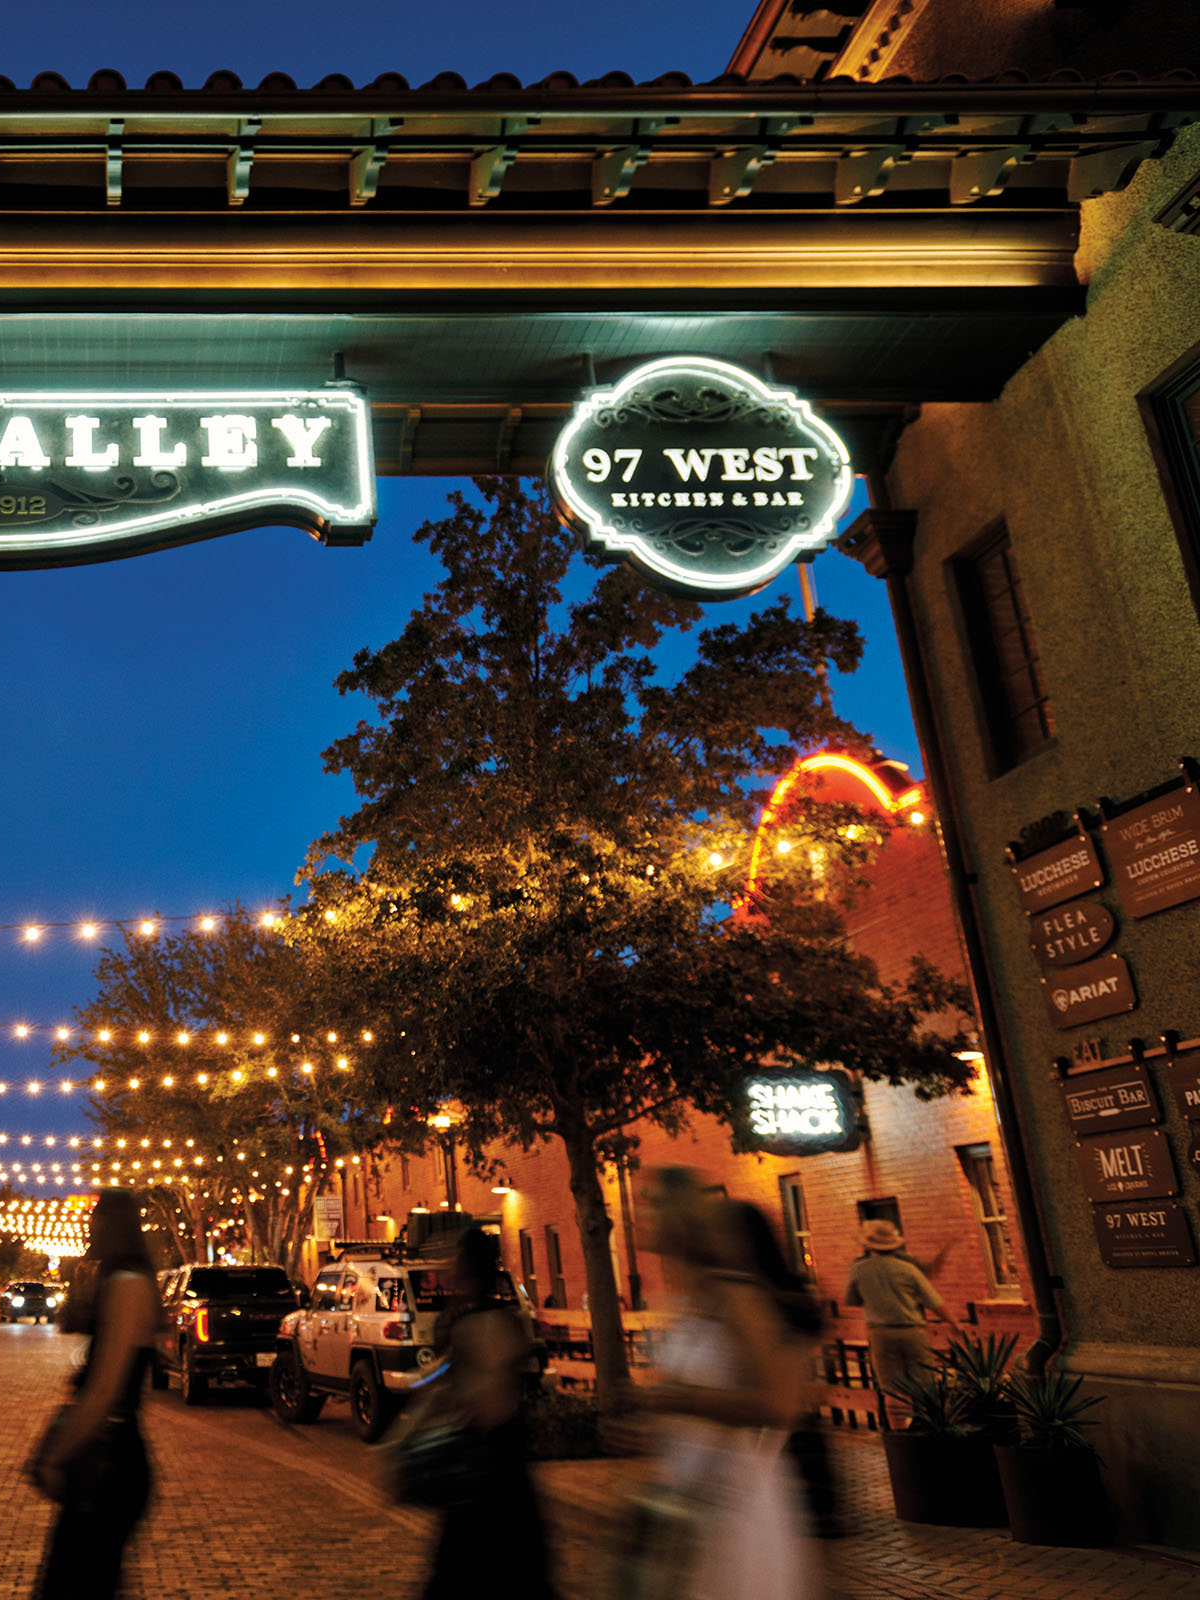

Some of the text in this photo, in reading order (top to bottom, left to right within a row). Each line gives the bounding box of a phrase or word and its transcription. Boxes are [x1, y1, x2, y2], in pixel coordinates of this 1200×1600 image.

[582, 446, 819, 483] 97 WEST
[611, 492, 805, 507] KITCHEN & BAR
[1120, 819, 1151, 841] WIDE
[1152, 804, 1184, 828] BRIM
[1019, 850, 1091, 893] LUCCHESE
[1126, 839, 1199, 879] LUCCHESE
[1043, 910, 1088, 935] FLEA
[1045, 926, 1100, 958] STYLE
[1069, 976, 1118, 1005] ARIAT
[1071, 1037, 1102, 1065] EAT
[748, 1083, 838, 1109] SHAKE
[750, 1108, 843, 1135] SHACK
[1100, 1145, 1145, 1179] MELT
[1105, 1211, 1166, 1229] 97 WEST
